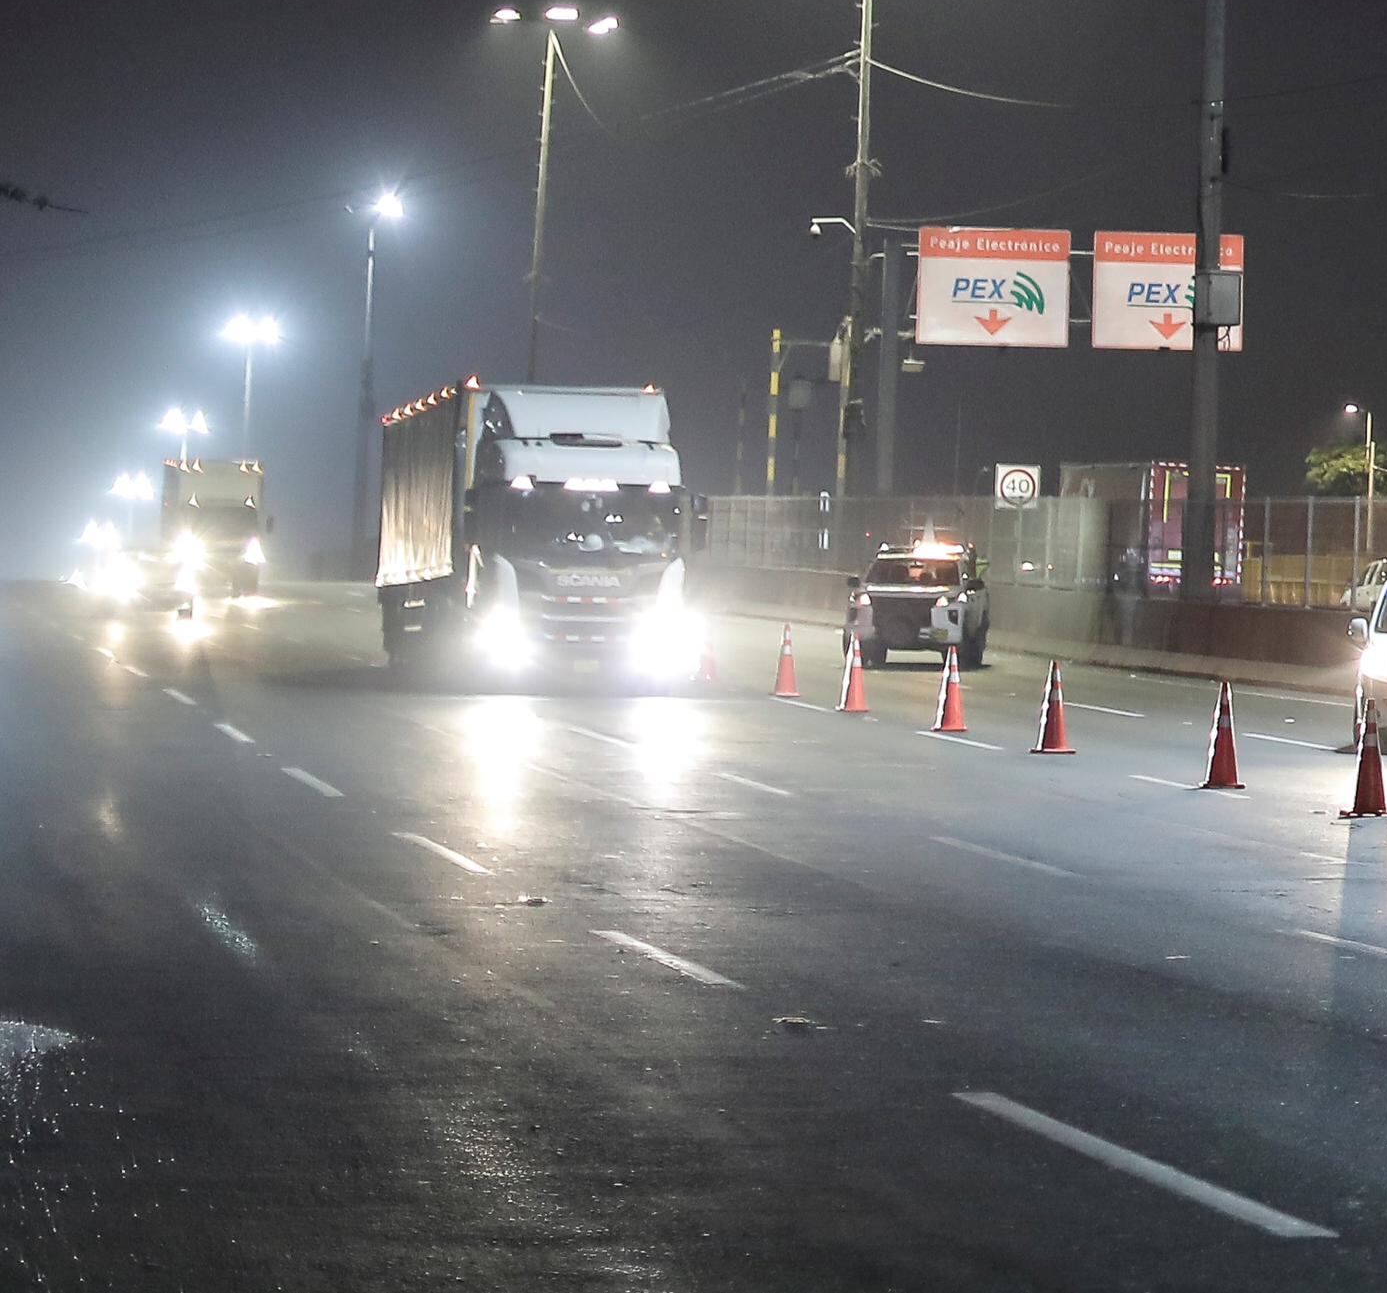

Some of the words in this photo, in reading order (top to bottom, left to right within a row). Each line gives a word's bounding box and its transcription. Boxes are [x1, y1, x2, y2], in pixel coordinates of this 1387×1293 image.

[930, 236, 970, 252] Peaje
[1104, 241, 1145, 257] Peaje
[952, 277, 1007, 300] PEX
[1127, 282, 1182, 304] PEX
[1006, 479, 1030, 493] 40
[557, 575, 621, 587] SCANIA
